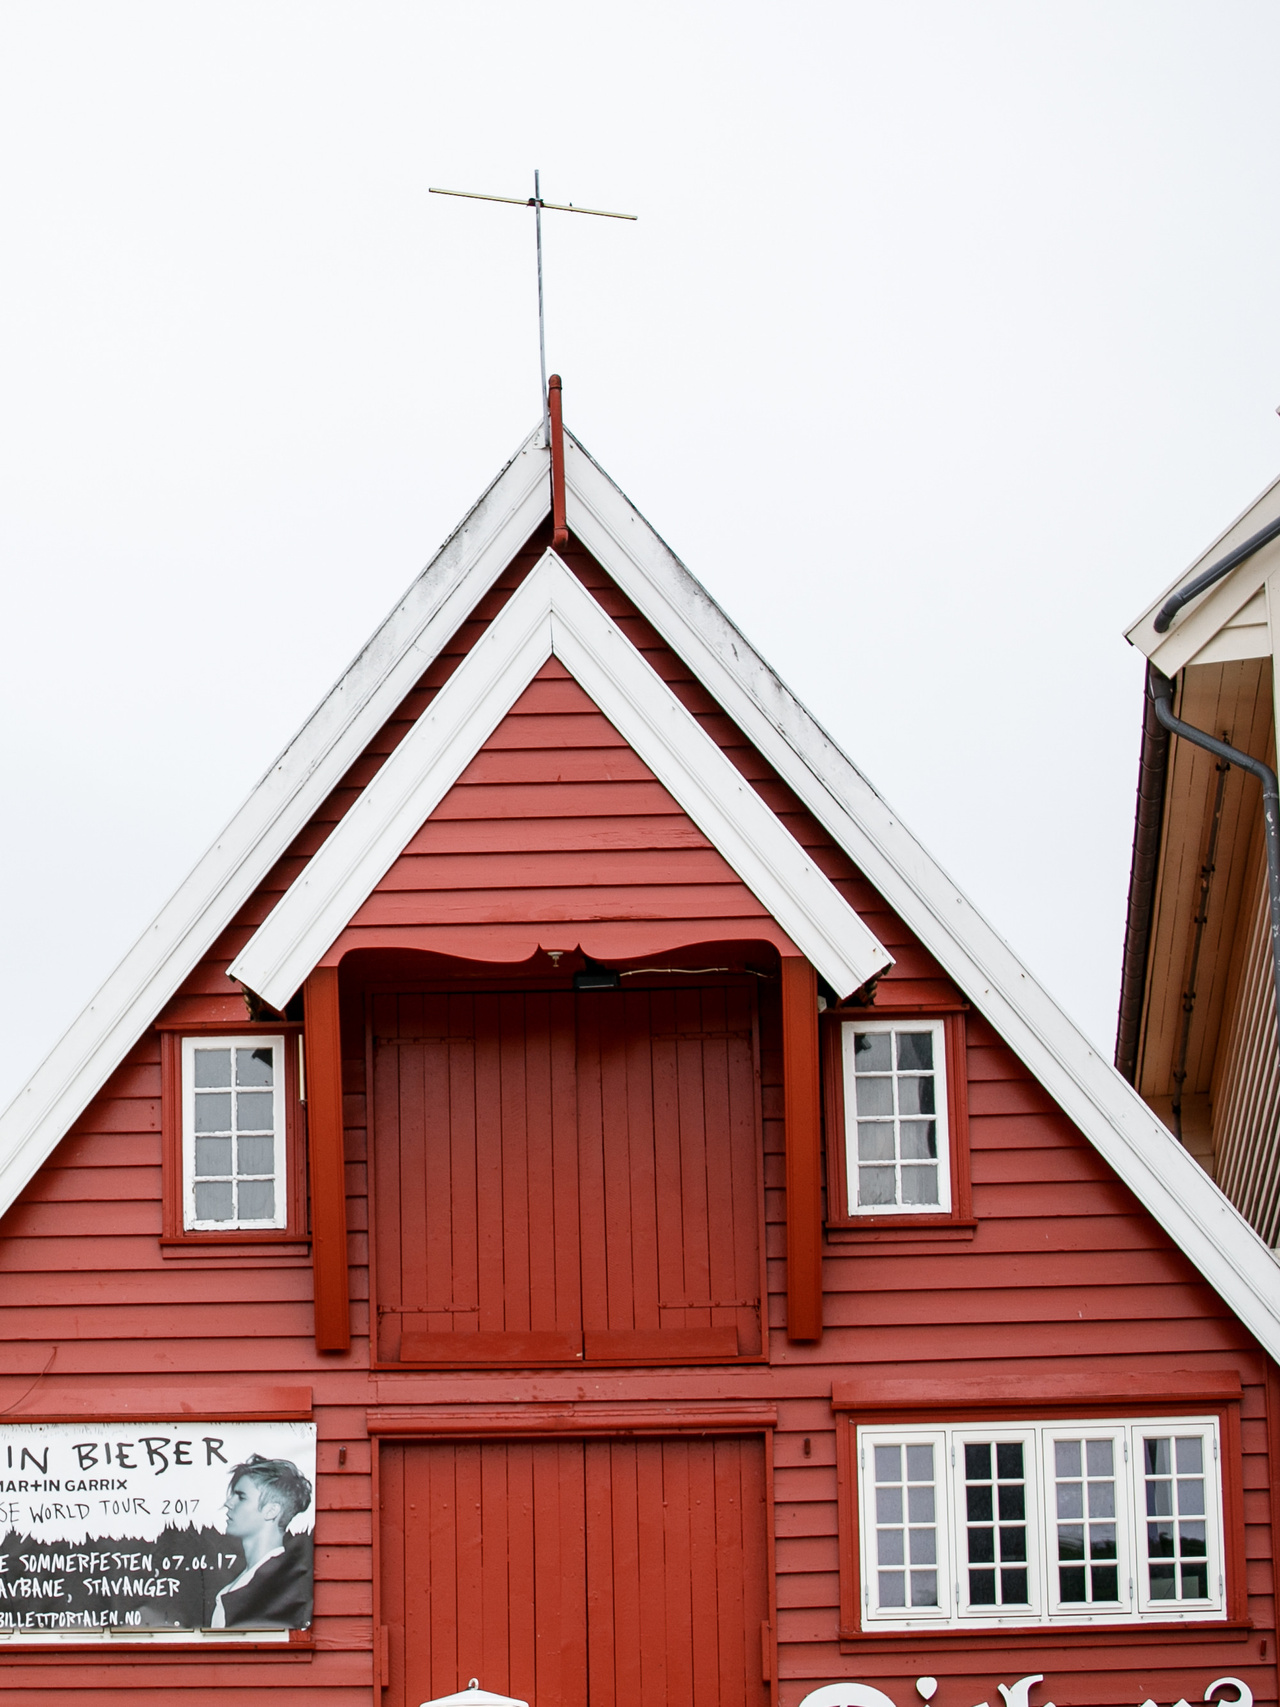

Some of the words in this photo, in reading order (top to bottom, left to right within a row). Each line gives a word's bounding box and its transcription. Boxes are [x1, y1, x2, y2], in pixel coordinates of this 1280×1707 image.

[72, 1437, 228, 1475] BIEBER
[64, 1478, 128, 1492] GARRIX
[29, 1502, 91, 1524] WORLD
[99, 1497, 151, 1515] TOUR
[161, 1499, 200, 1516] 2017
[162, 1552, 238, 1571] 07.06.17
[82, 1575, 181, 1598] STAVANGER
